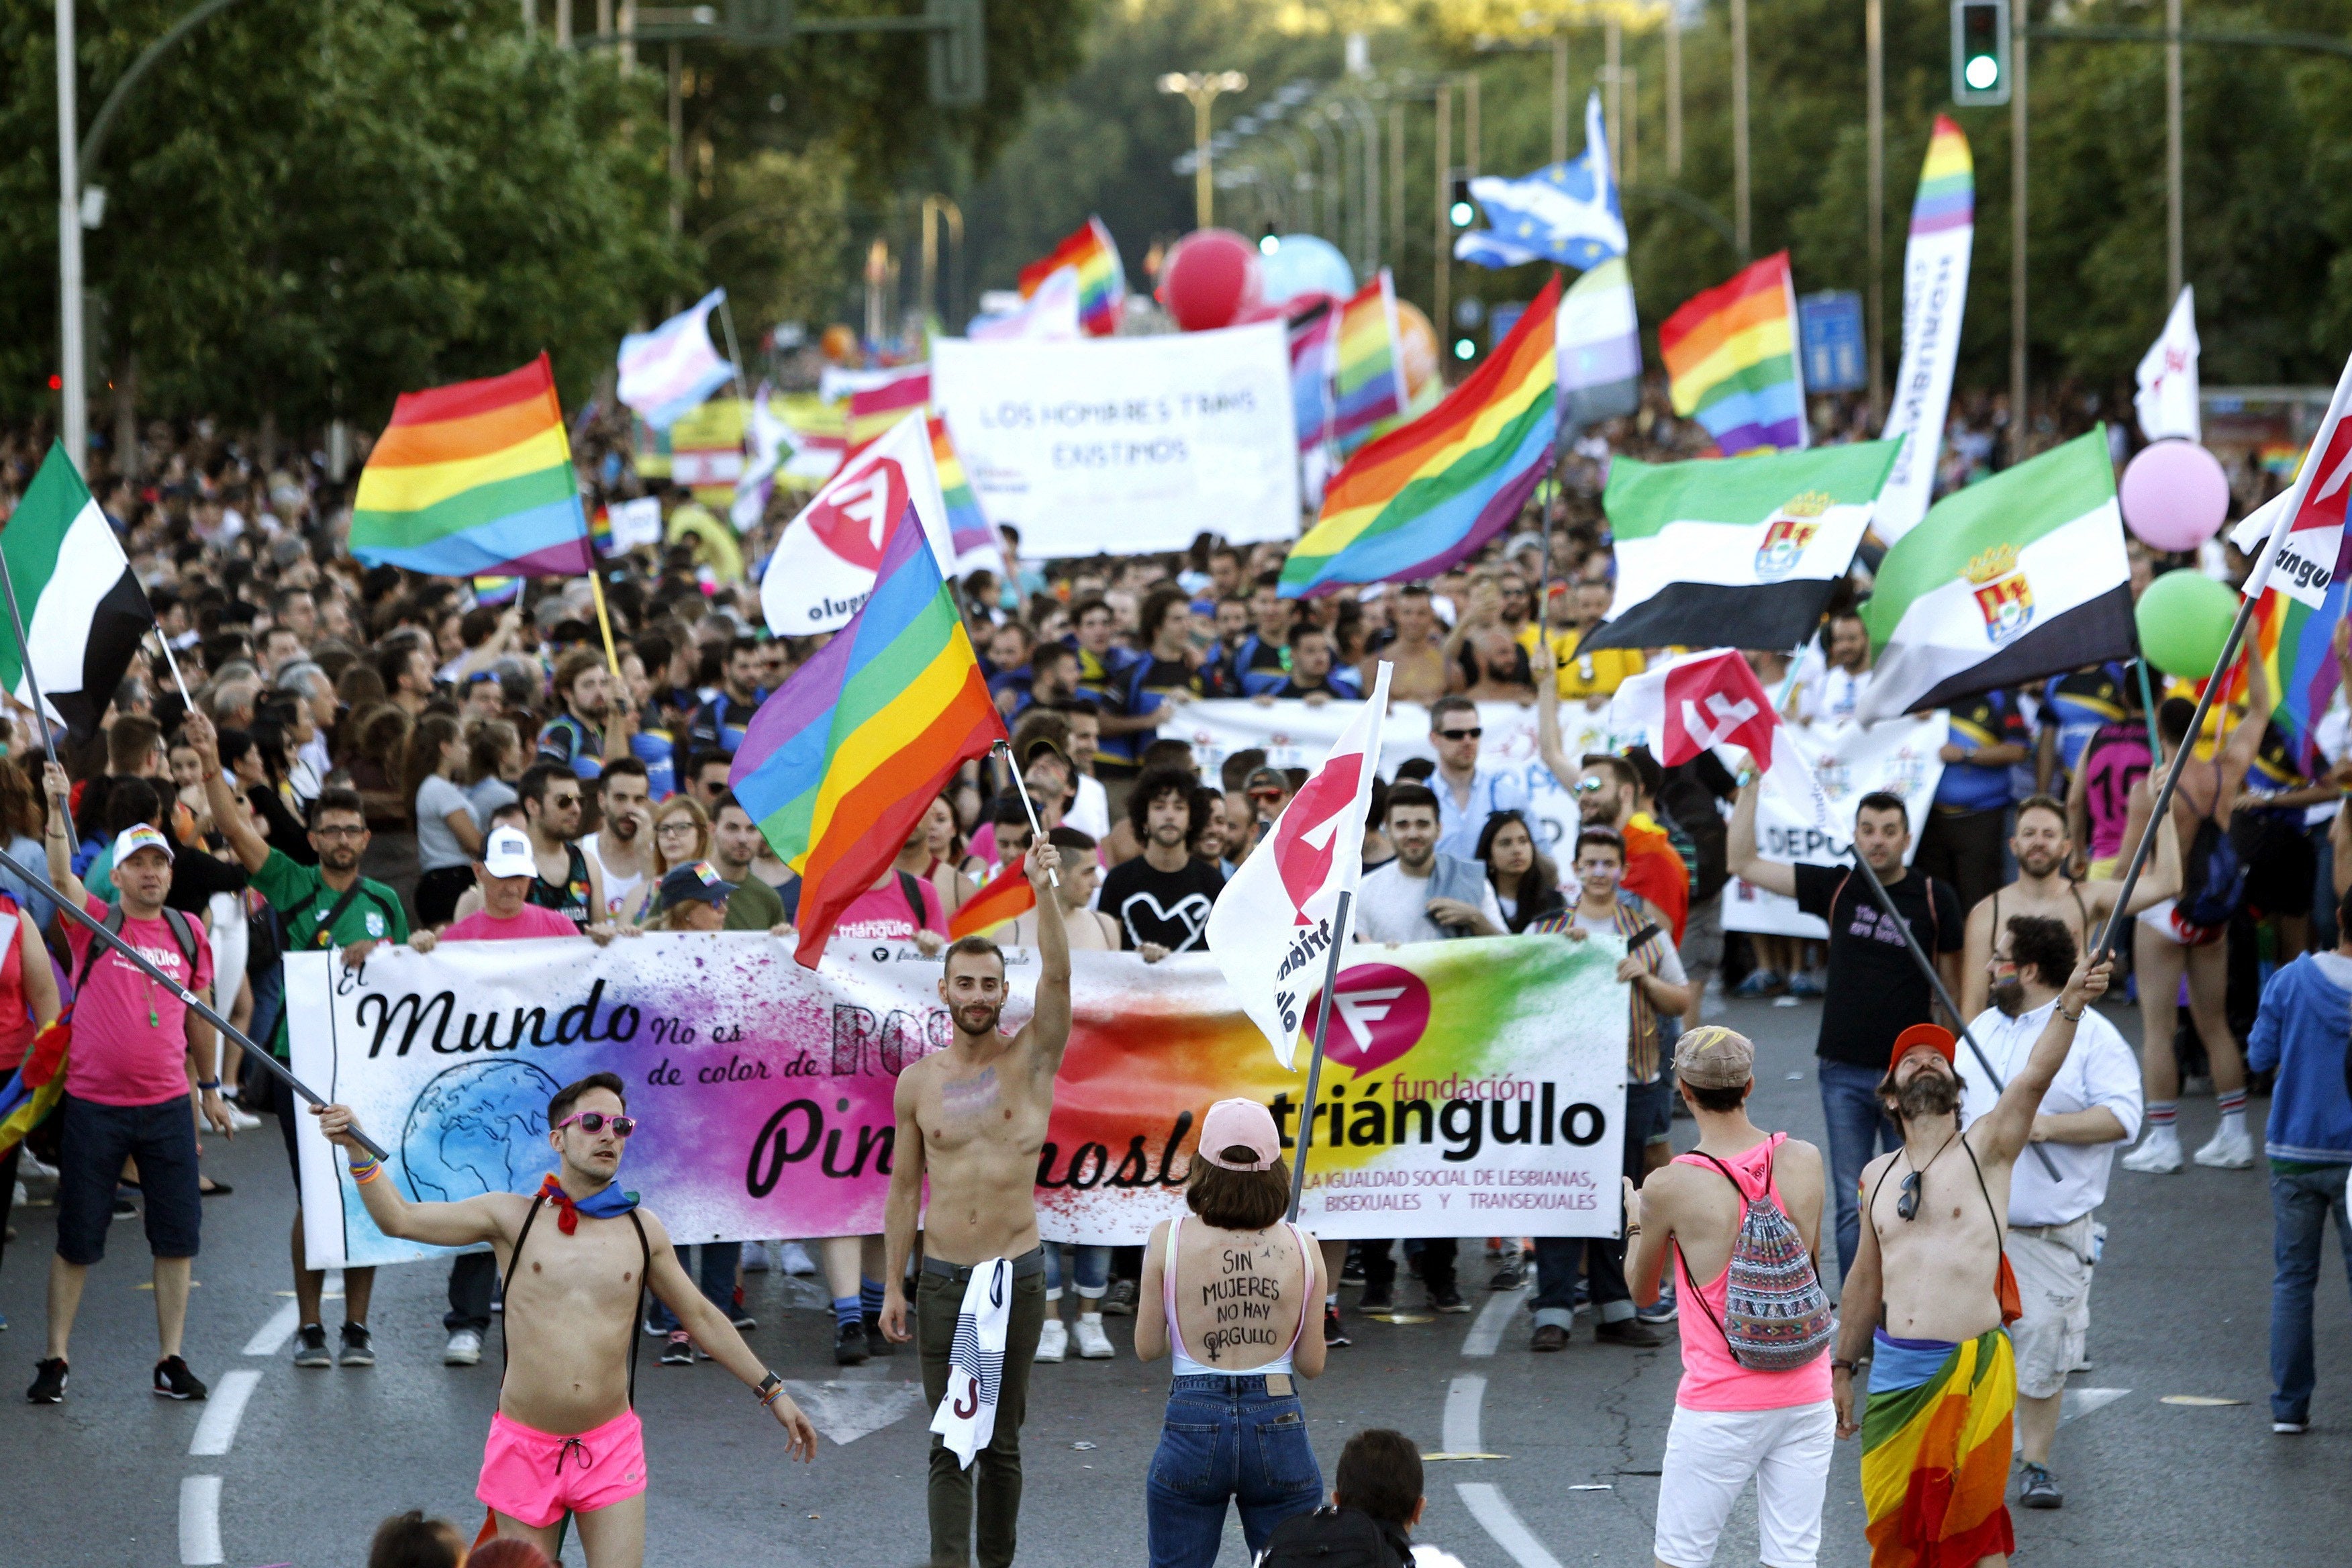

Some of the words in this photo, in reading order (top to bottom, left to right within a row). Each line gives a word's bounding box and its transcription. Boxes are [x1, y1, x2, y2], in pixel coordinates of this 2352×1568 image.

[979, 399, 1035, 428] LOS
[1040, 395, 1172, 428] HOMBRES
[337, 961, 369, 995] El
[356, 979, 640, 1058] Mundo
[650, 1017, 696, 1045] No
[712, 1024, 746, 1044] es
[647, 1058, 685, 1085] de
[698, 1055, 771, 1083] color
[784, 1049, 822, 1077] de
[1391, 1073, 1534, 1101] fundación
[1269, 1081, 1606, 1162] triángulo
[1302, 1172, 1321, 1190] LA
[1325, 1171, 1409, 1189] IGUALDAD
[1412, 1169, 1472, 1187] SOCIAL
[1473, 1169, 1496, 1186] DE
[1499, 1169, 1597, 1191] LESBIANAS,
[1325, 1193, 1422, 1212] BISEXUALES
[1438, 1193, 1451, 1210] Y
[1469, 1193, 1598, 1210] TRANSEXUALES
[1222, 1249, 1253, 1274] SIN
[1202, 1277, 1280, 1306] MUJERES
[1217, 1304, 1238, 1323] NO
[1243, 1301, 1271, 1320] HAY
[1204, 1327, 1277, 1362] ORGULLO
